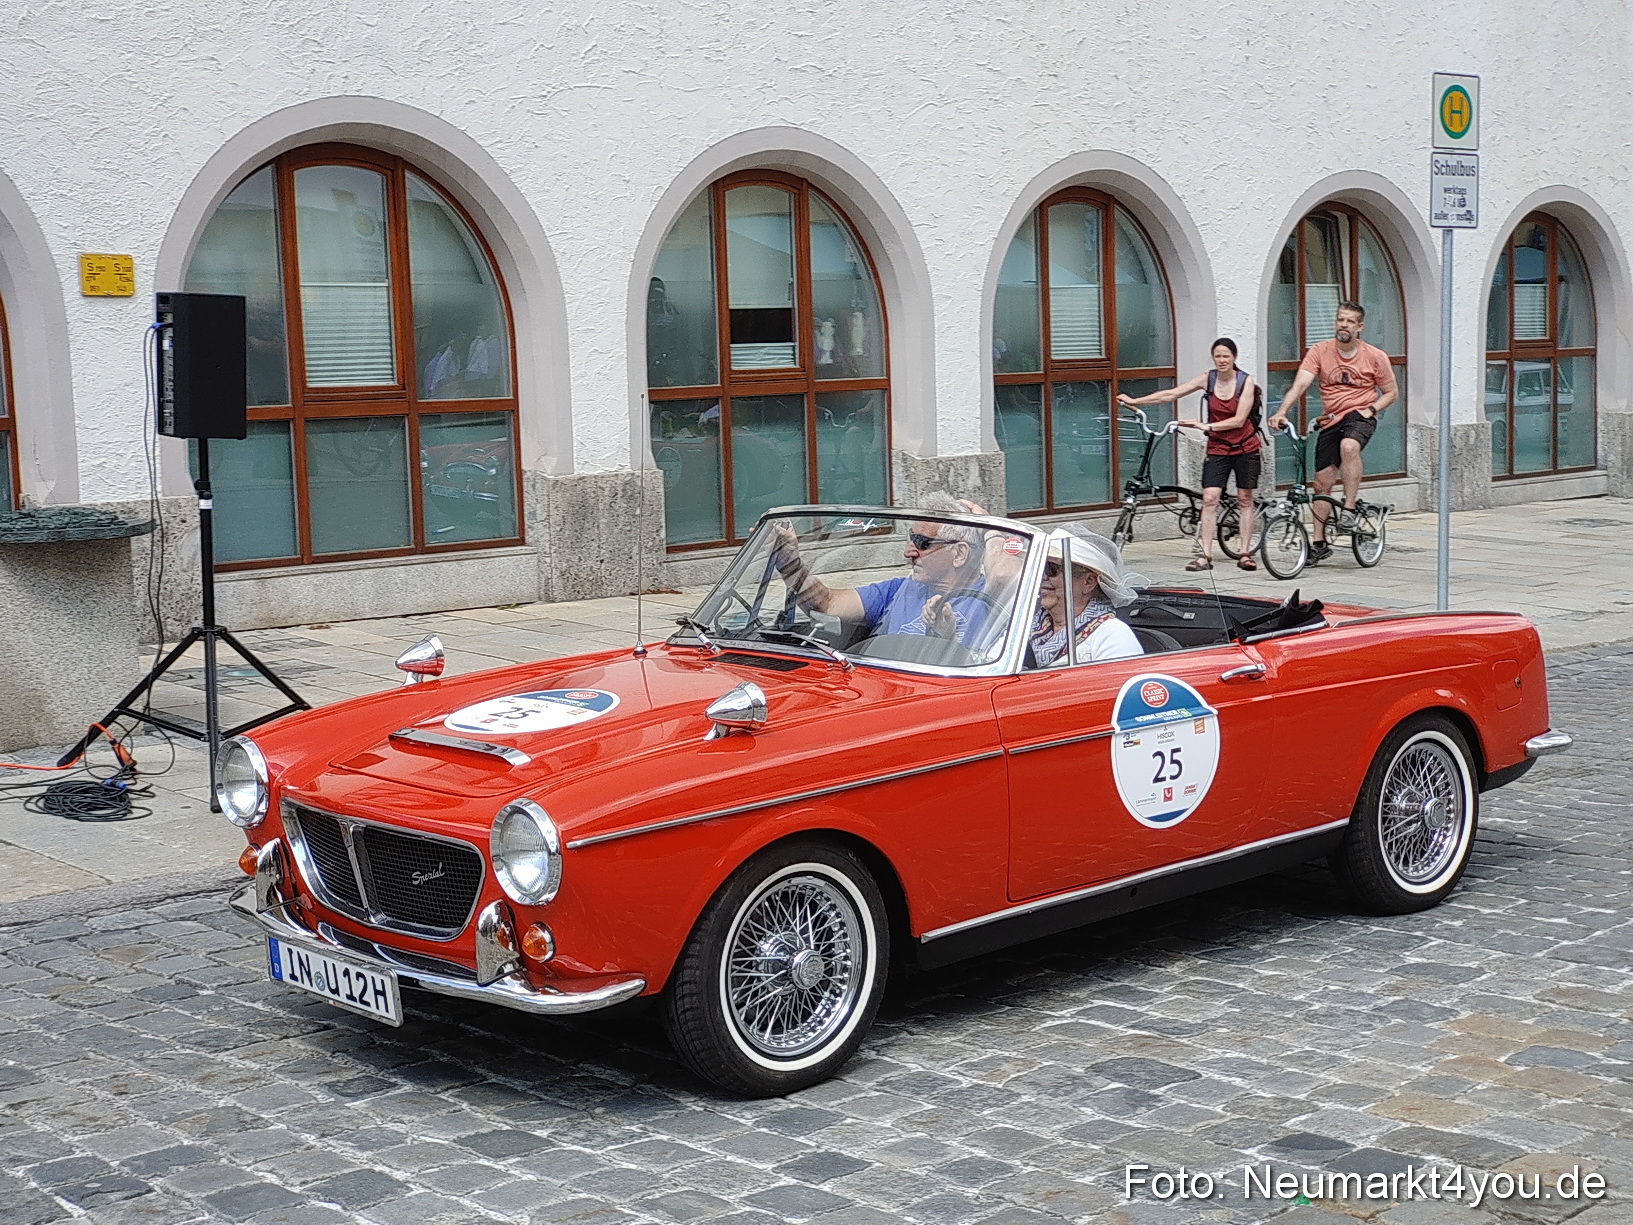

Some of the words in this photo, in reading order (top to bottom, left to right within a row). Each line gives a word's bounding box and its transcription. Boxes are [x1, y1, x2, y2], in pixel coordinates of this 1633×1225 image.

[1449, 95, 1464, 128] H
[1433, 159, 1476, 177] Schulbus
[1156, 731, 1175, 740] HISCOX
[1151, 746, 1183, 784] 25
[287, 947, 314, 988] IN
